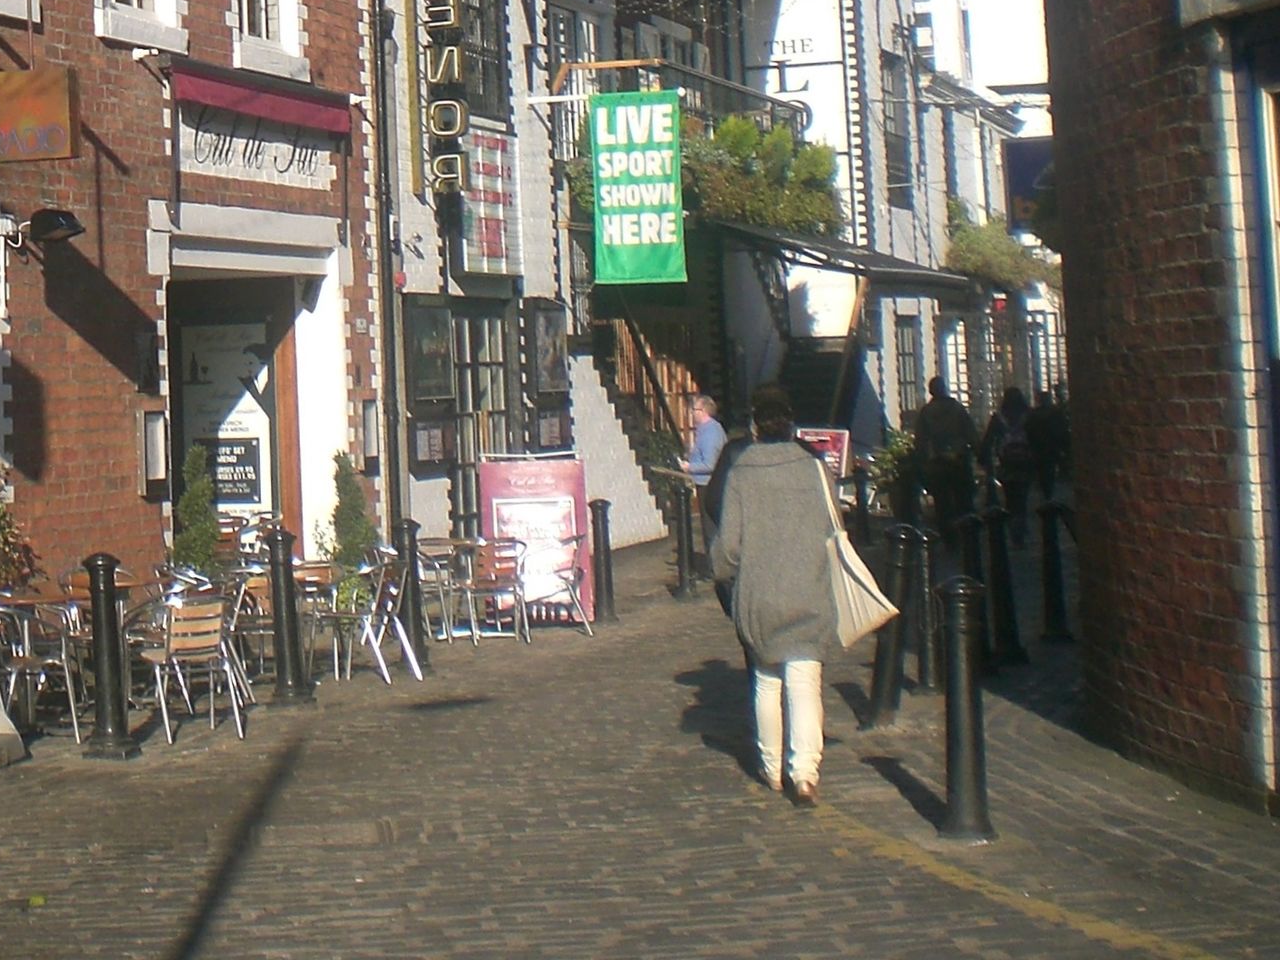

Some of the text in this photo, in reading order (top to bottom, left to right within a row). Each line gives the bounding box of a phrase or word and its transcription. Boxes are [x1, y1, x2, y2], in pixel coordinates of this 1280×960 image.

[764, 38, 813, 55] THE
[596, 104, 674, 145] LIVE
[598, 150, 674, 178] SPORT
[600, 182, 676, 208] SHOWN
[602, 212, 677, 245] HERE
